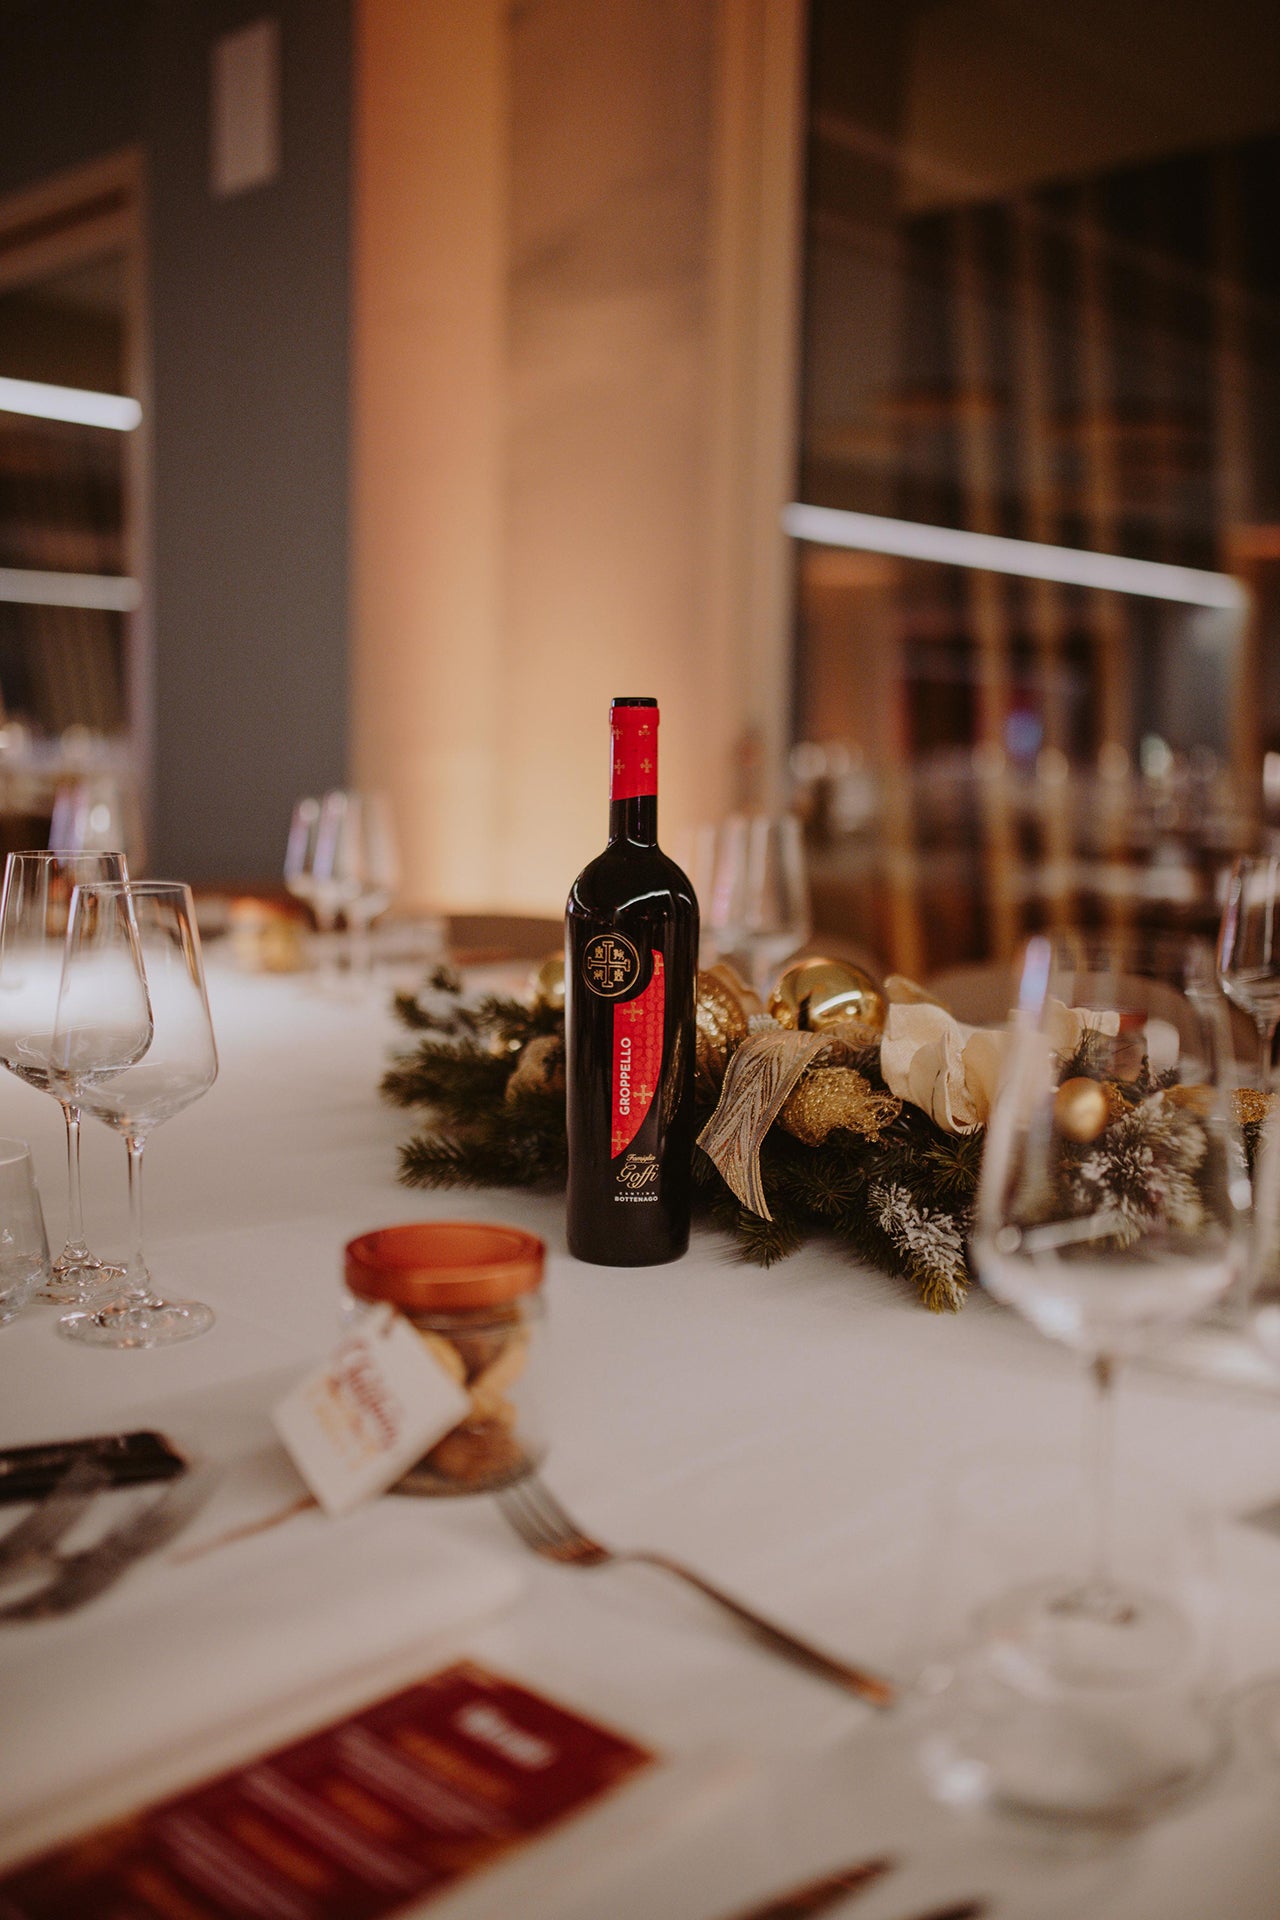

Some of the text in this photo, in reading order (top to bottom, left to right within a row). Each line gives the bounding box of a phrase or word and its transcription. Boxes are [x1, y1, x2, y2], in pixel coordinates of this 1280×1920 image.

[619, 1037, 632, 1116] GROPPELLO
[616, 1162, 660, 1189] Goffi
[614, 1195, 659, 1203] BOTTENAGO
